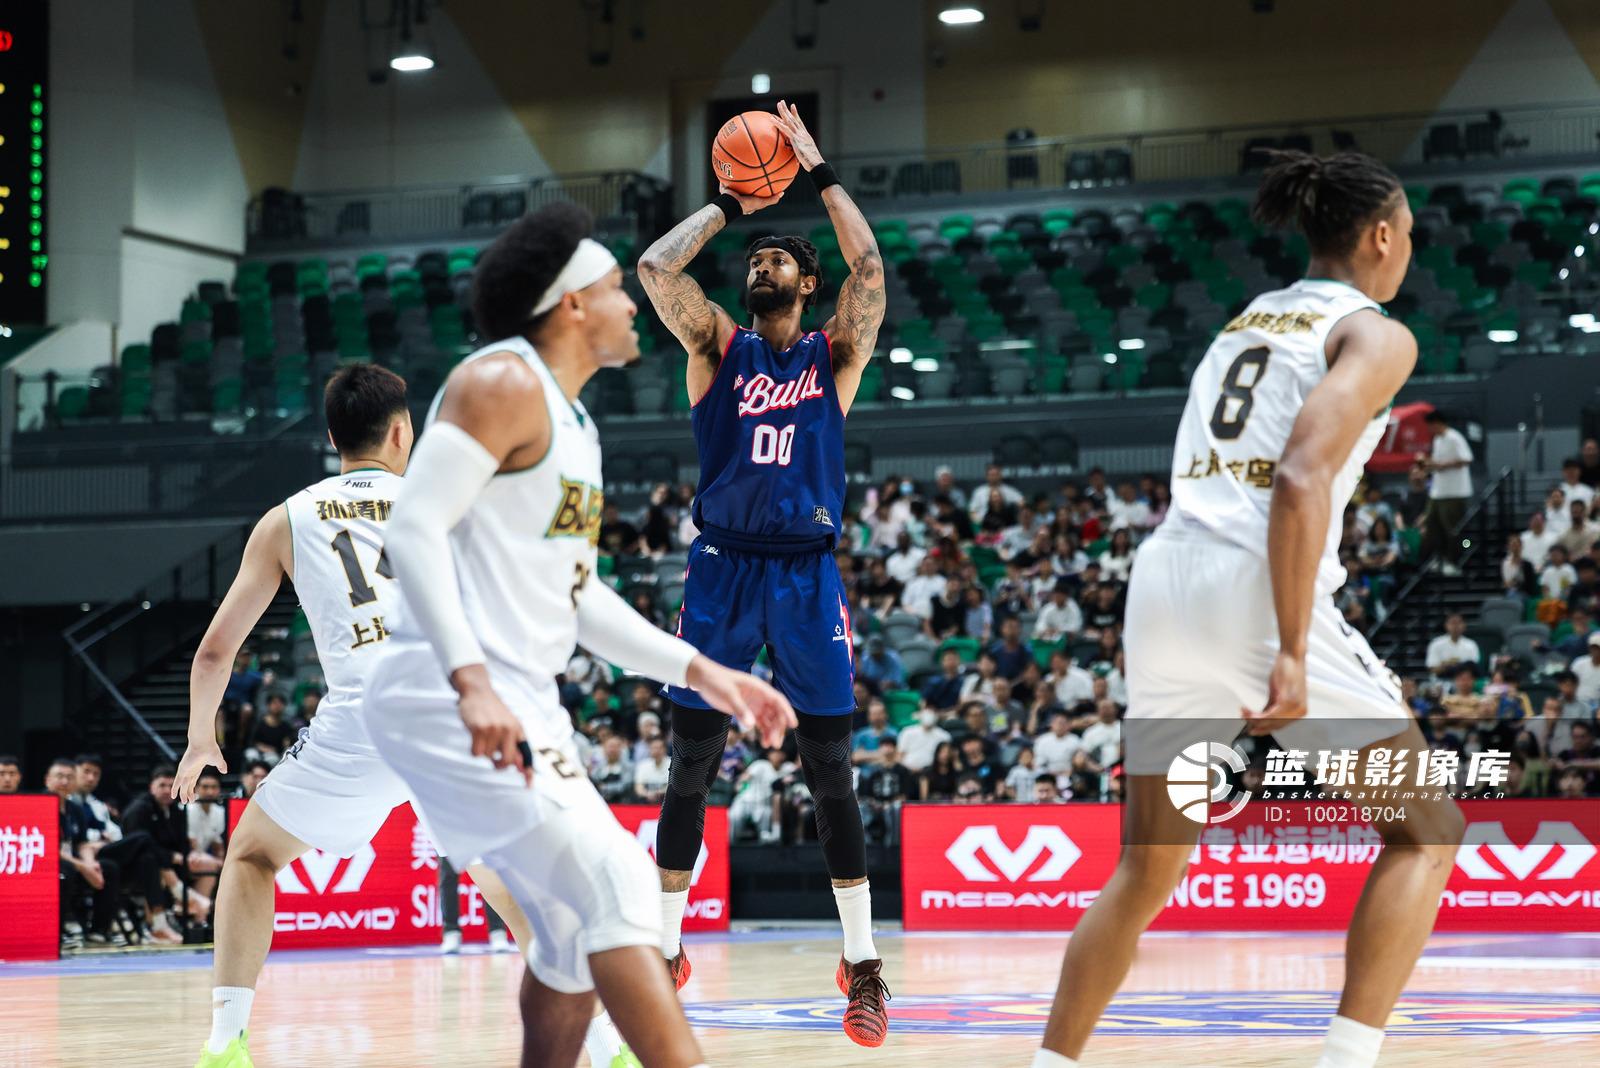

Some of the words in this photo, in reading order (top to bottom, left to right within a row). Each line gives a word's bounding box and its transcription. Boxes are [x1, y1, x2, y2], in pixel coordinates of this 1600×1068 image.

[1210, 345, 1271, 440] 8
[752, 424, 796, 466] 00
[1188, 825, 1384, 865] 专业运动防
[411, 884, 485, 928] SIE
[1166, 873, 1235, 908] NCE
[1243, 873, 1327, 908] 1969
[1438, 890, 1600, 908] CDAVI
[273, 907, 396, 932] CDAVID
